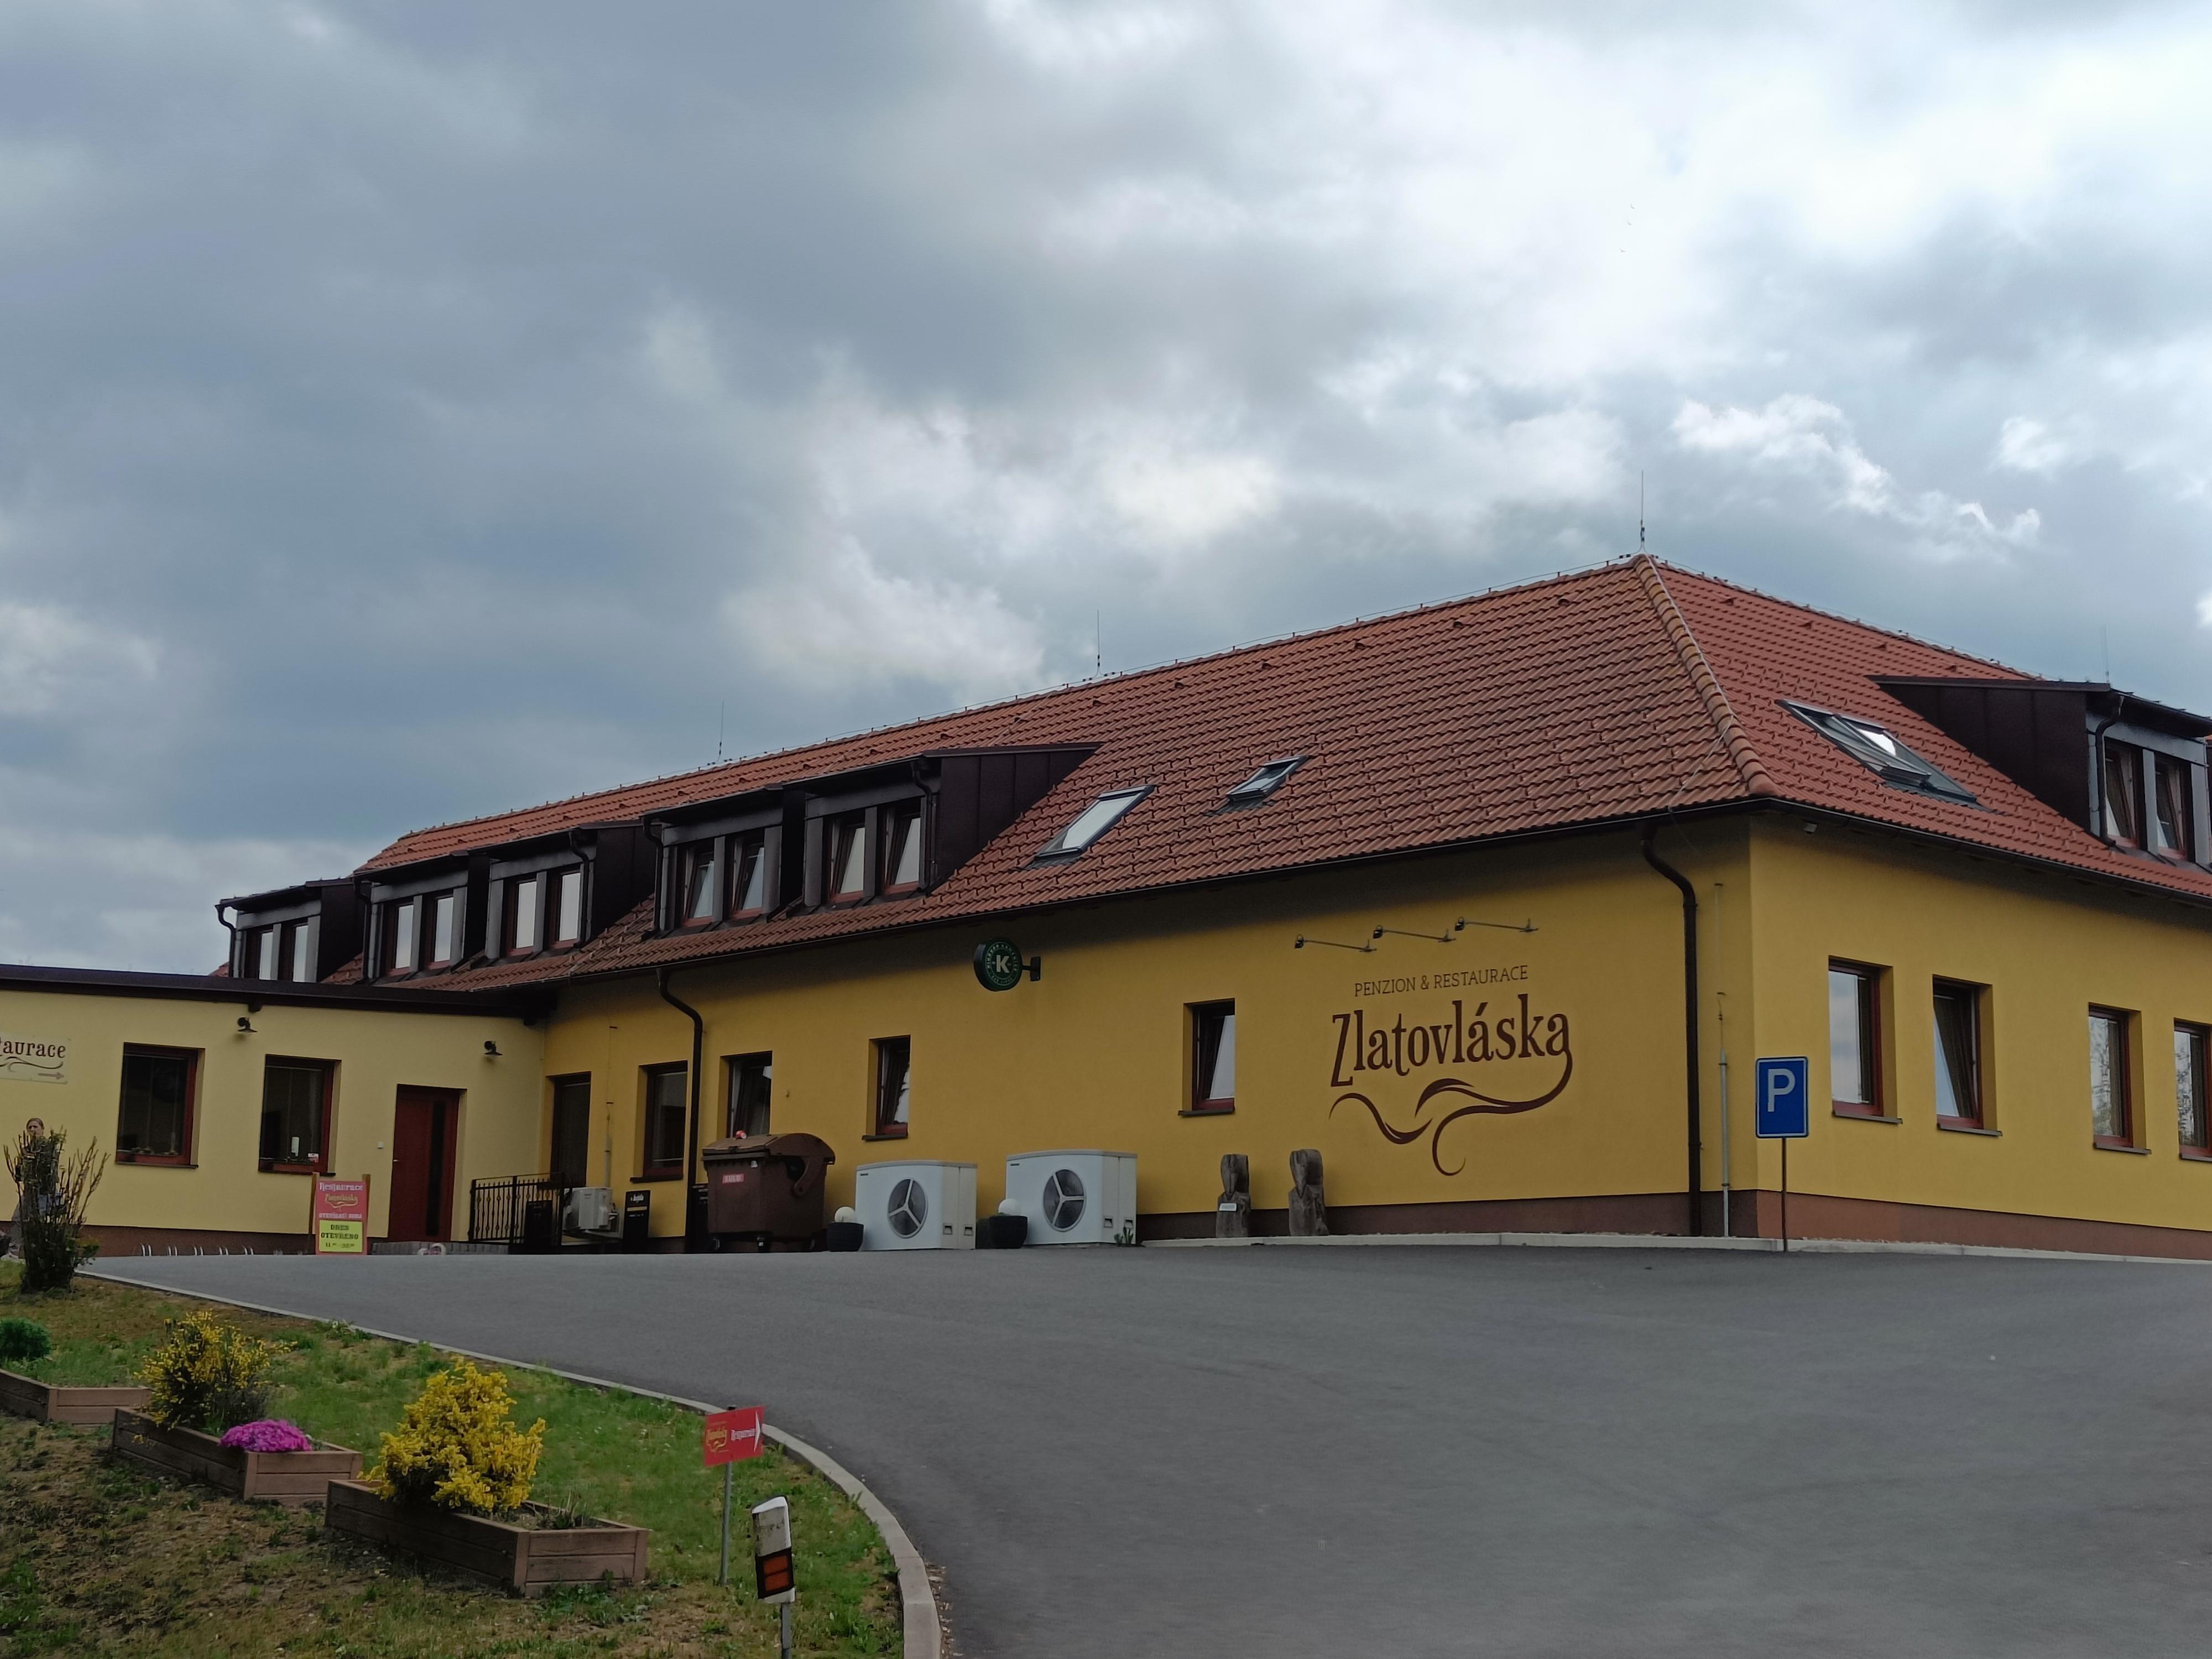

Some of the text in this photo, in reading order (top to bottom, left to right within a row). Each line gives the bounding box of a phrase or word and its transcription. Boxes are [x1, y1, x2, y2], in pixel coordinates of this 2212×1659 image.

[996, 954, 1010, 973] K
[1355, 965, 1528, 997] PENZION & RESTAURACE
[1331, 994, 1572, 1087] Zlatovláska
[1767, 1068, 1795, 1112] P
